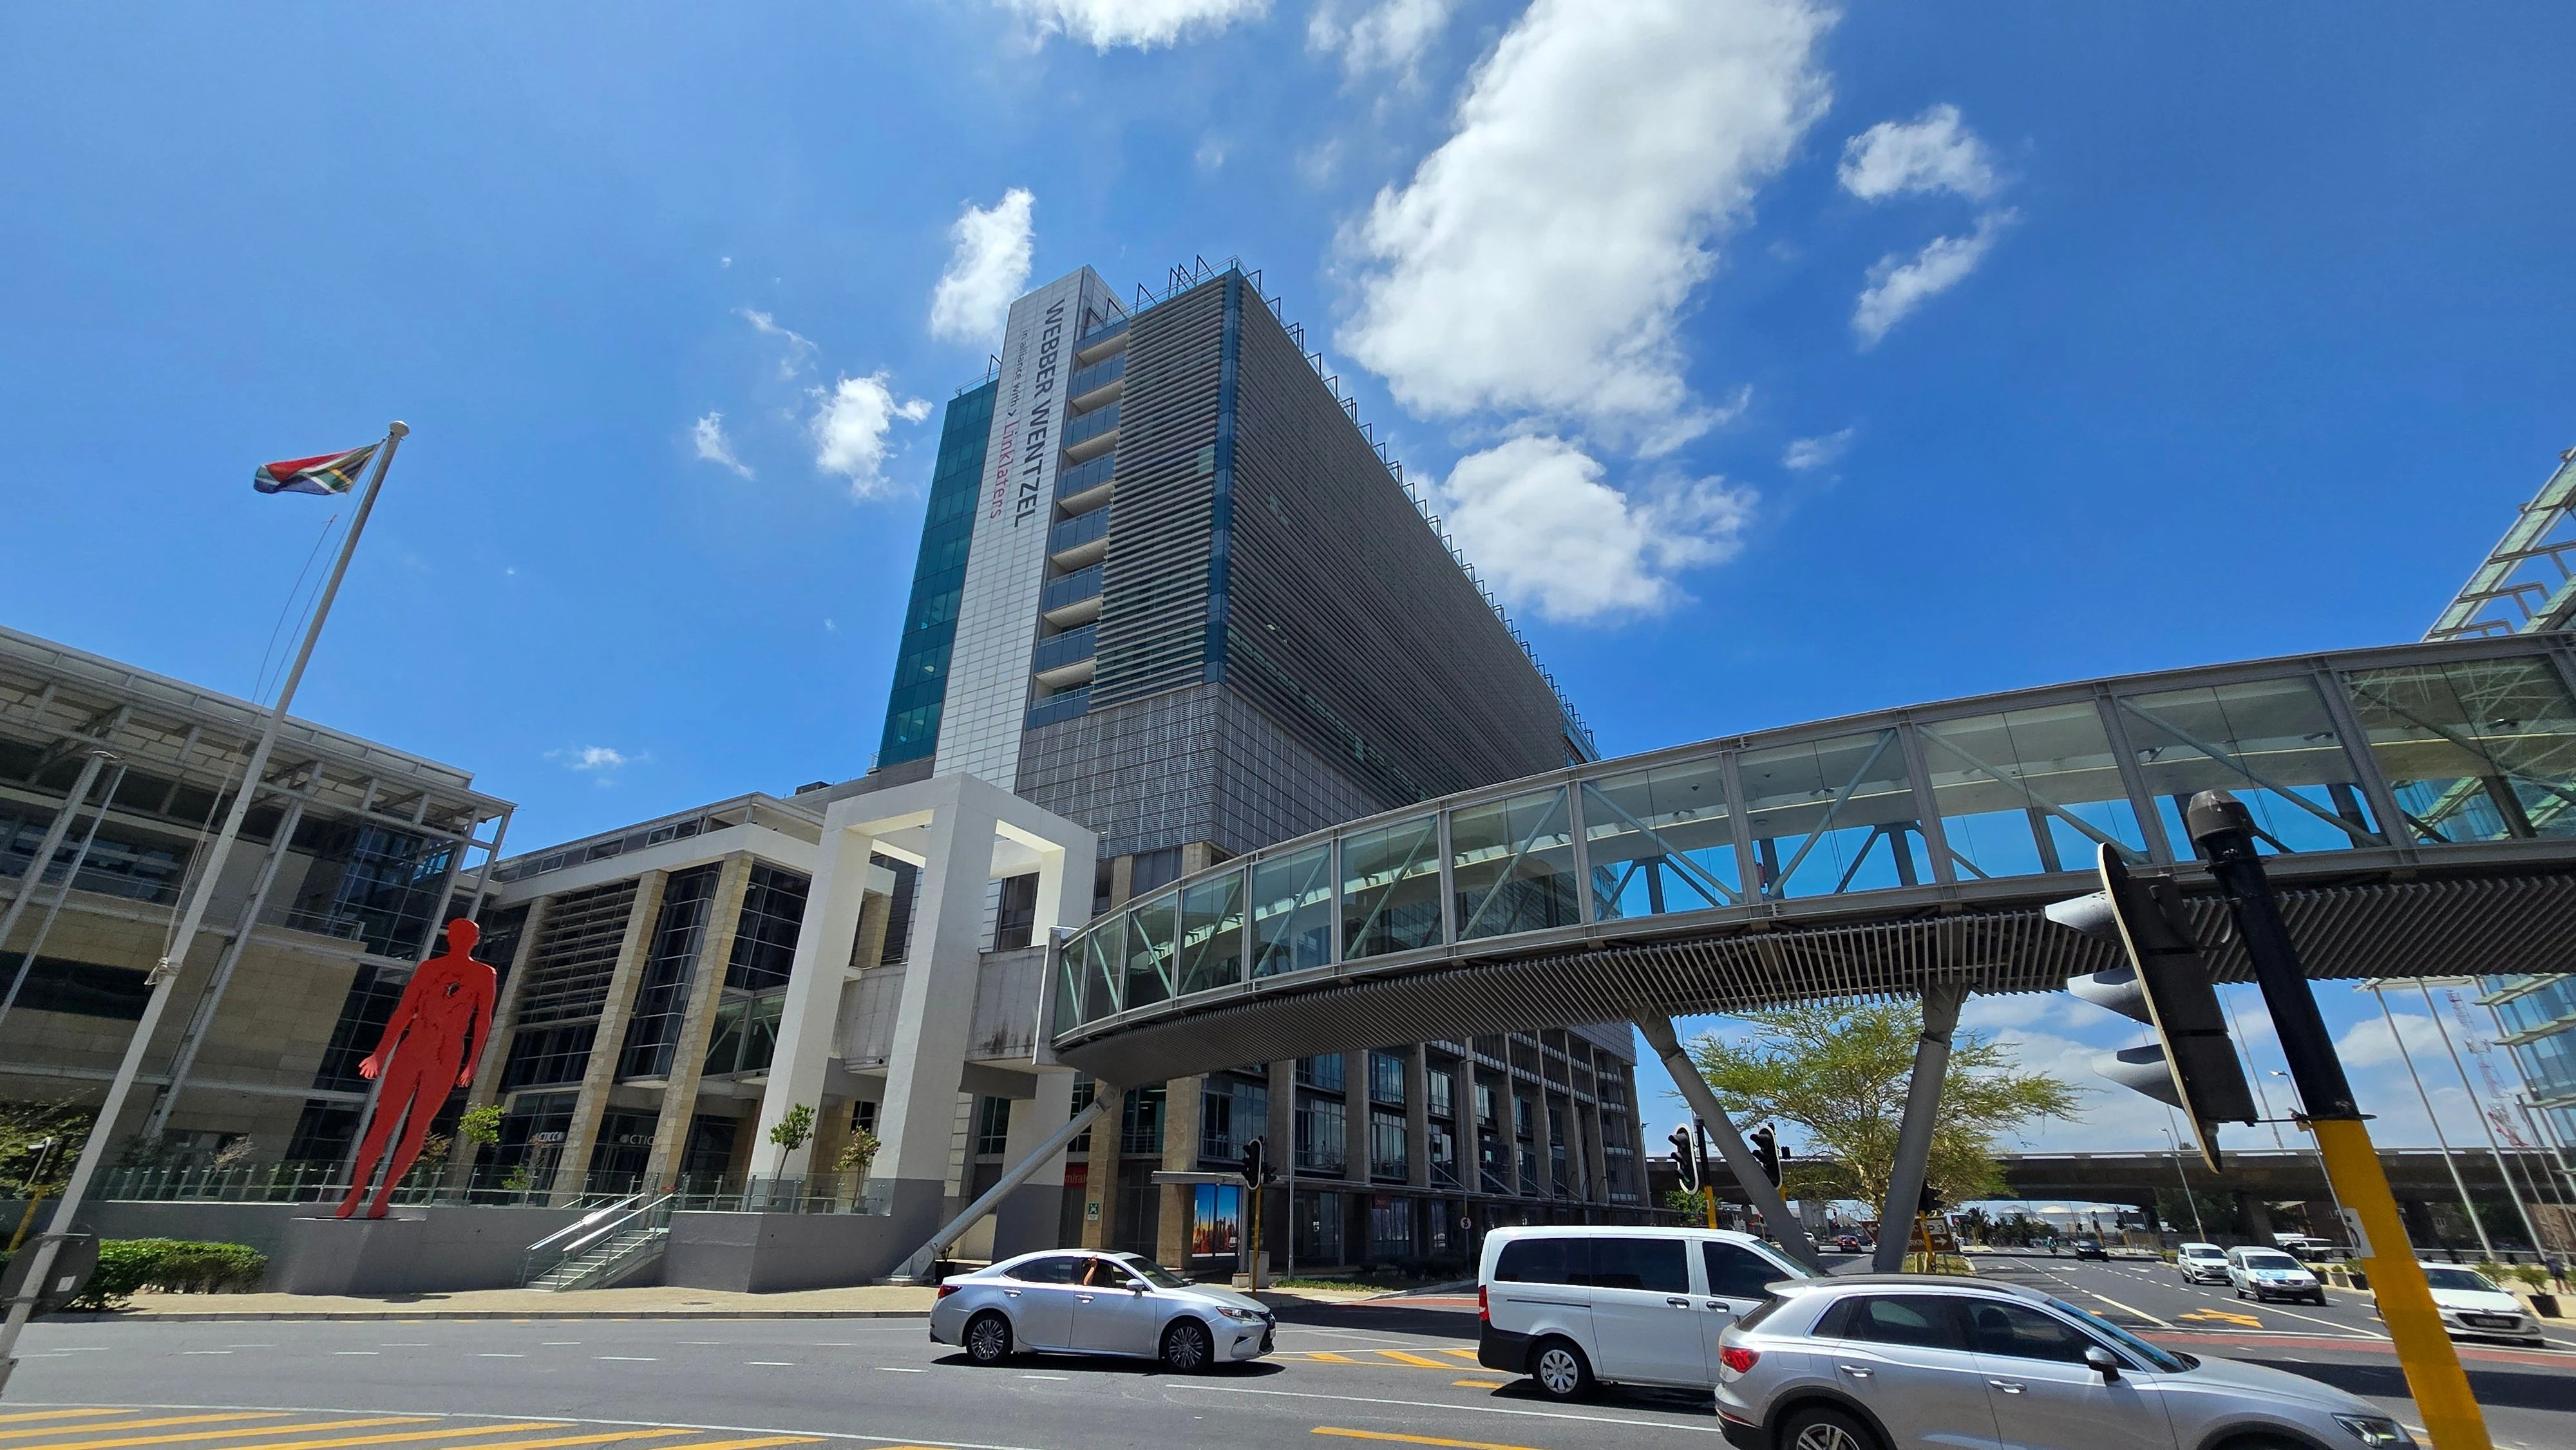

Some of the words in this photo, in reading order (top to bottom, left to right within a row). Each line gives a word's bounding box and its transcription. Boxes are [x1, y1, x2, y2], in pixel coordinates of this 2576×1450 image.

[1021, 328, 1030, 340] in
[1033, 298, 1065, 399] WEBBER
[1014, 341, 1028, 381] alliance
[1010, 382, 1021, 407] with
[990, 420, 1019, 519] Linklaters
[1014, 399, 1051, 527] WENTZEL
[630, 1135, 655, 1145] CTIC
[1937, 1224, 1944, 1233] 3
